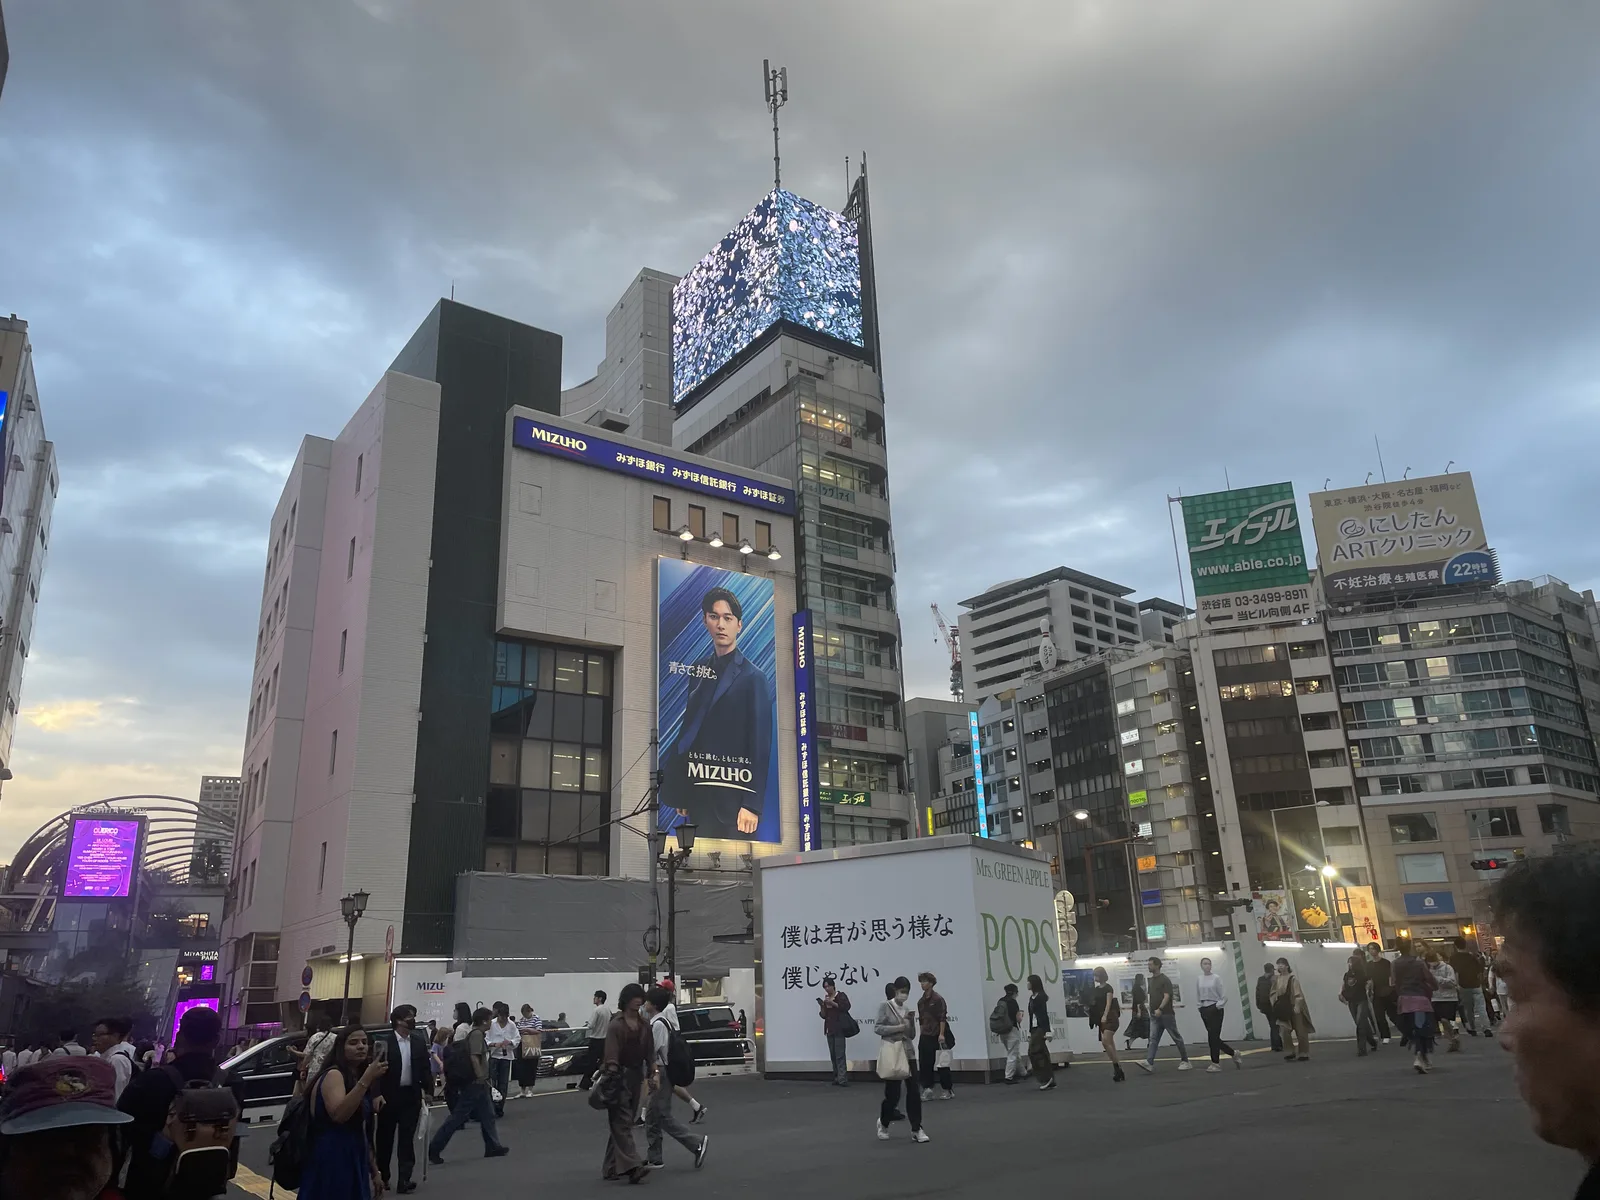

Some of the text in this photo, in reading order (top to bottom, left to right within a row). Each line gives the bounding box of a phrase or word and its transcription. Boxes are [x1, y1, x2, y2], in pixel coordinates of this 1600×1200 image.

[531, 426, 588, 452] MIZUHO
[616, 452, 666, 474] みずほ銀行
[672, 467, 737, 493] みずほ信託銀行
[743, 485, 786, 505] みずほ証券
[1190, 498, 1297, 552] エイブル
[1368, 508, 1456, 536] にしたん
[1332, 528, 1474, 562] ARTクリニック
[1197, 553, 1302, 577] www.able.co.jp
[1333, 569, 1440, 591] 不妊治療 生殖医療
[1201, 589, 1309, 611] 渋谷店 03-3499-8911
[798, 626, 807, 669] MIZUHO
[669, 661, 718, 680] 青さで、挑む。
[799, 692, 808, 737] みずほ証券
[687, 762, 753, 783] MIZUHO
[975, 857, 1050, 888] Mrs. GREEN APPLE
[781, 913, 955, 950] 僕は君が思う様な
[980, 912, 1059, 985] POPS
[782, 962, 880, 991] 僕じゃない
